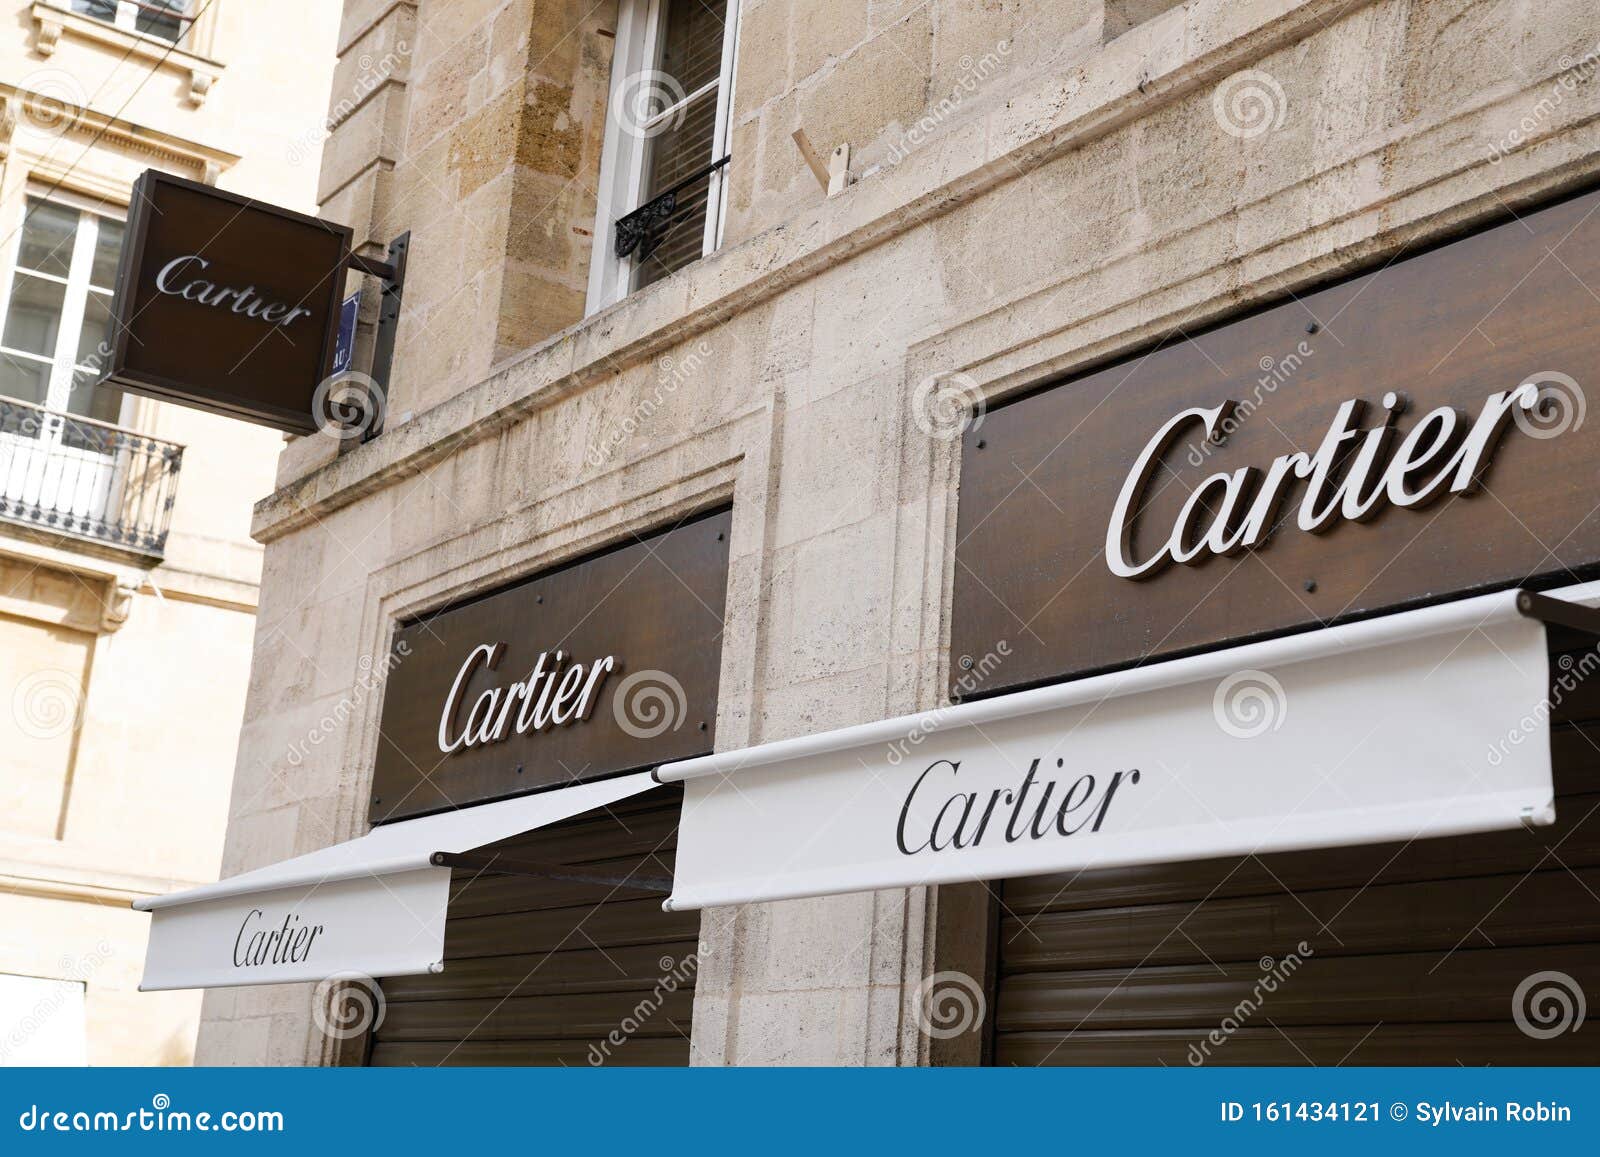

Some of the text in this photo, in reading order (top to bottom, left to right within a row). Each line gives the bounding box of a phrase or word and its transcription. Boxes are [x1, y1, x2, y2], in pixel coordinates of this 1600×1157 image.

[156, 256, 311, 325] Cartier
[1105, 384, 1540, 579] Cartier
[438, 642, 616, 753] Cartier
[897, 758, 1140, 855] Cartier
[233, 909, 323, 967] Cartier
